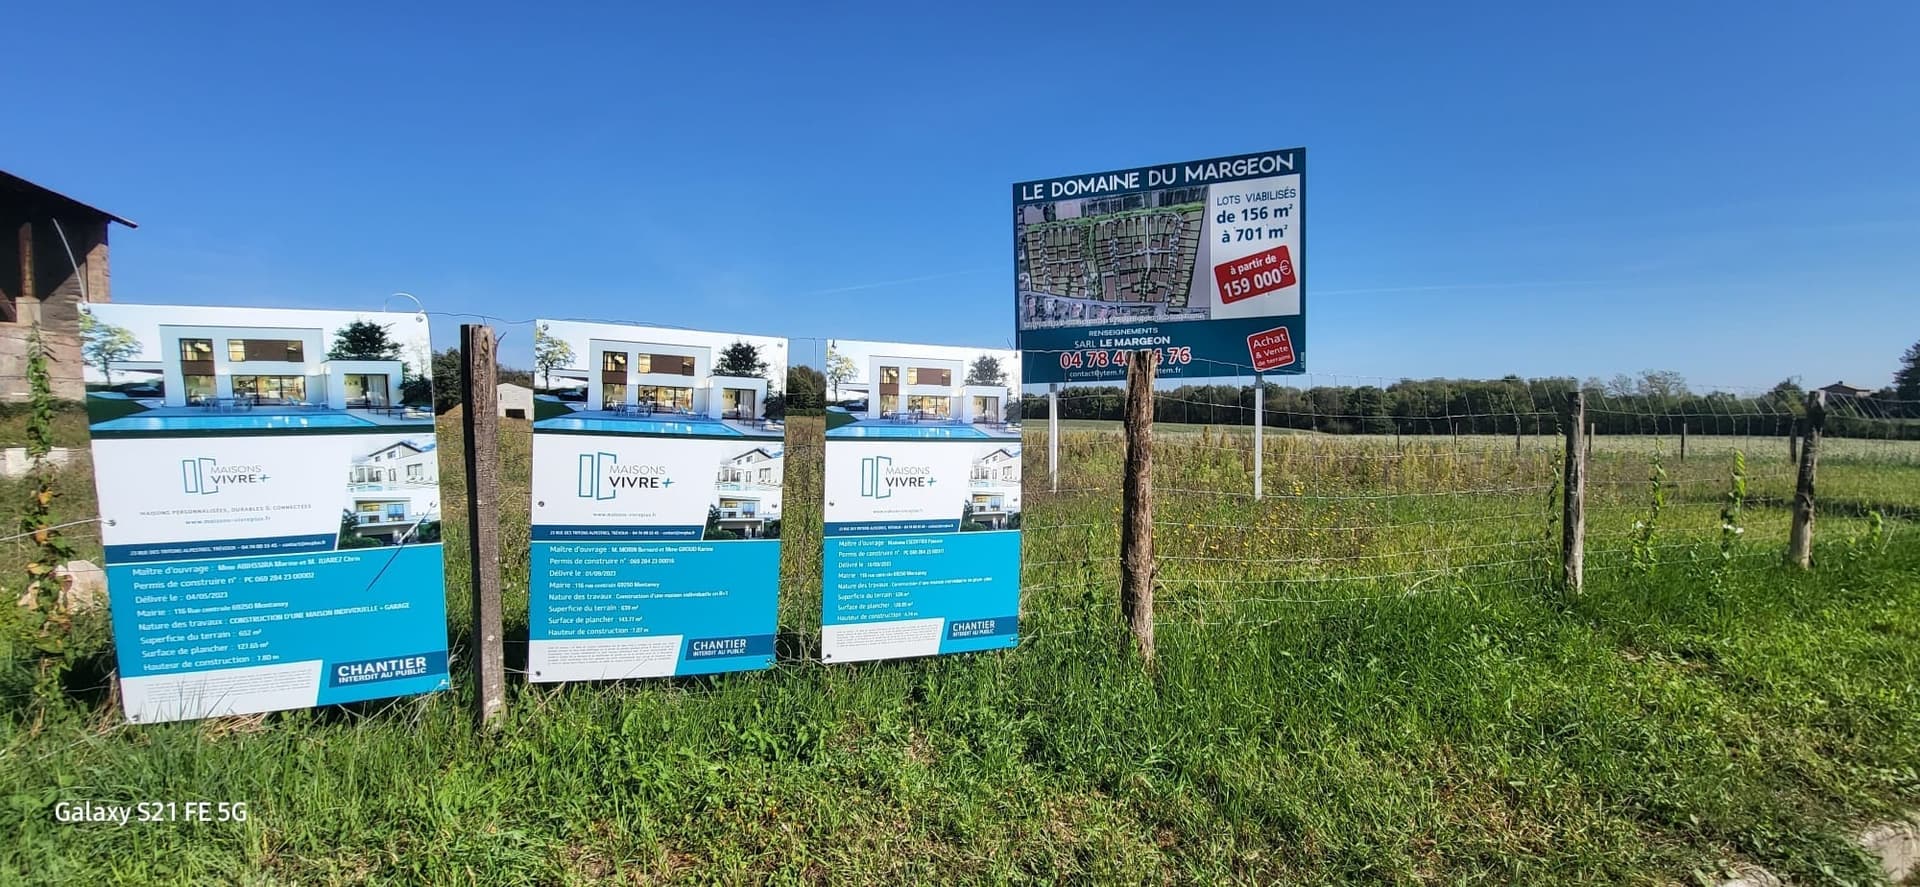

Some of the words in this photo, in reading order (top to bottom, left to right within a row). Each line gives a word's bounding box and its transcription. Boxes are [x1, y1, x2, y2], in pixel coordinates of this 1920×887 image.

[1022, 183, 1044, 200] LE
[1052, 172, 1139, 197] DOMAINE
[1149, 167, 1176, 186] DU
[1185, 154, 1294, 182] MARGEON
[1217, 195, 1240, 206] LOTS
[1246, 188, 1296, 203] VIABILISÉS
[1217, 210, 1235, 224] de
[1242, 206, 1268, 221] 156
[1273, 204, 1293, 218] m²
[1222, 231, 1230, 243] à
[1236, 228, 1262, 242] 701
[1269, 225, 1288, 239] m²
[1230, 266, 1236, 275] à
[1238, 258, 1263, 274] partir
[1265, 255, 1277, 265] de
[1224, 278, 1250, 298] 159
[1089, 328, 1158, 337] RENSEIGNEMENTS
[1074, 340, 1096, 348] SARL
[1100, 339, 1112, 347] LE
[1114, 336, 1170, 347] MARGEON
[1252, 333, 1286, 348] Achat
[1060, 352, 1083, 369] 04
[1087, 350, 1109, 368] 78
[1167, 346, 1192, 364] 76
[1256, 352, 1262, 360] &
[1264, 346, 1289, 357] Vente
[210, 465, 262, 474] MAISONS
[609, 465, 665, 474] MAISONS
[886, 466, 930, 474] MAISONS
[574, 546, 607, 554] d'ouvrage
[132, 568, 163, 576] Maître
[165, 566, 208, 574] d'ouvrage
[180, 578, 226, 587] construire
[548, 605, 582, 613] Superficie
[230, 614, 282, 623] CONSTRUCTION
[306, 610, 332, 618] MAISON
[952, 620, 995, 631] CHANTIER
[140, 635, 185, 645] Superficie
[693, 639, 746, 651] CHANTIER
[142, 649, 176, 658] Surface
[191, 645, 228, 655] plancher
[194, 657, 249, 667] construction
[338, 656, 426, 678] CHANTIER
[339, 674, 378, 684] INTERDIT
[396, 667, 426, 678] PUBLIC
